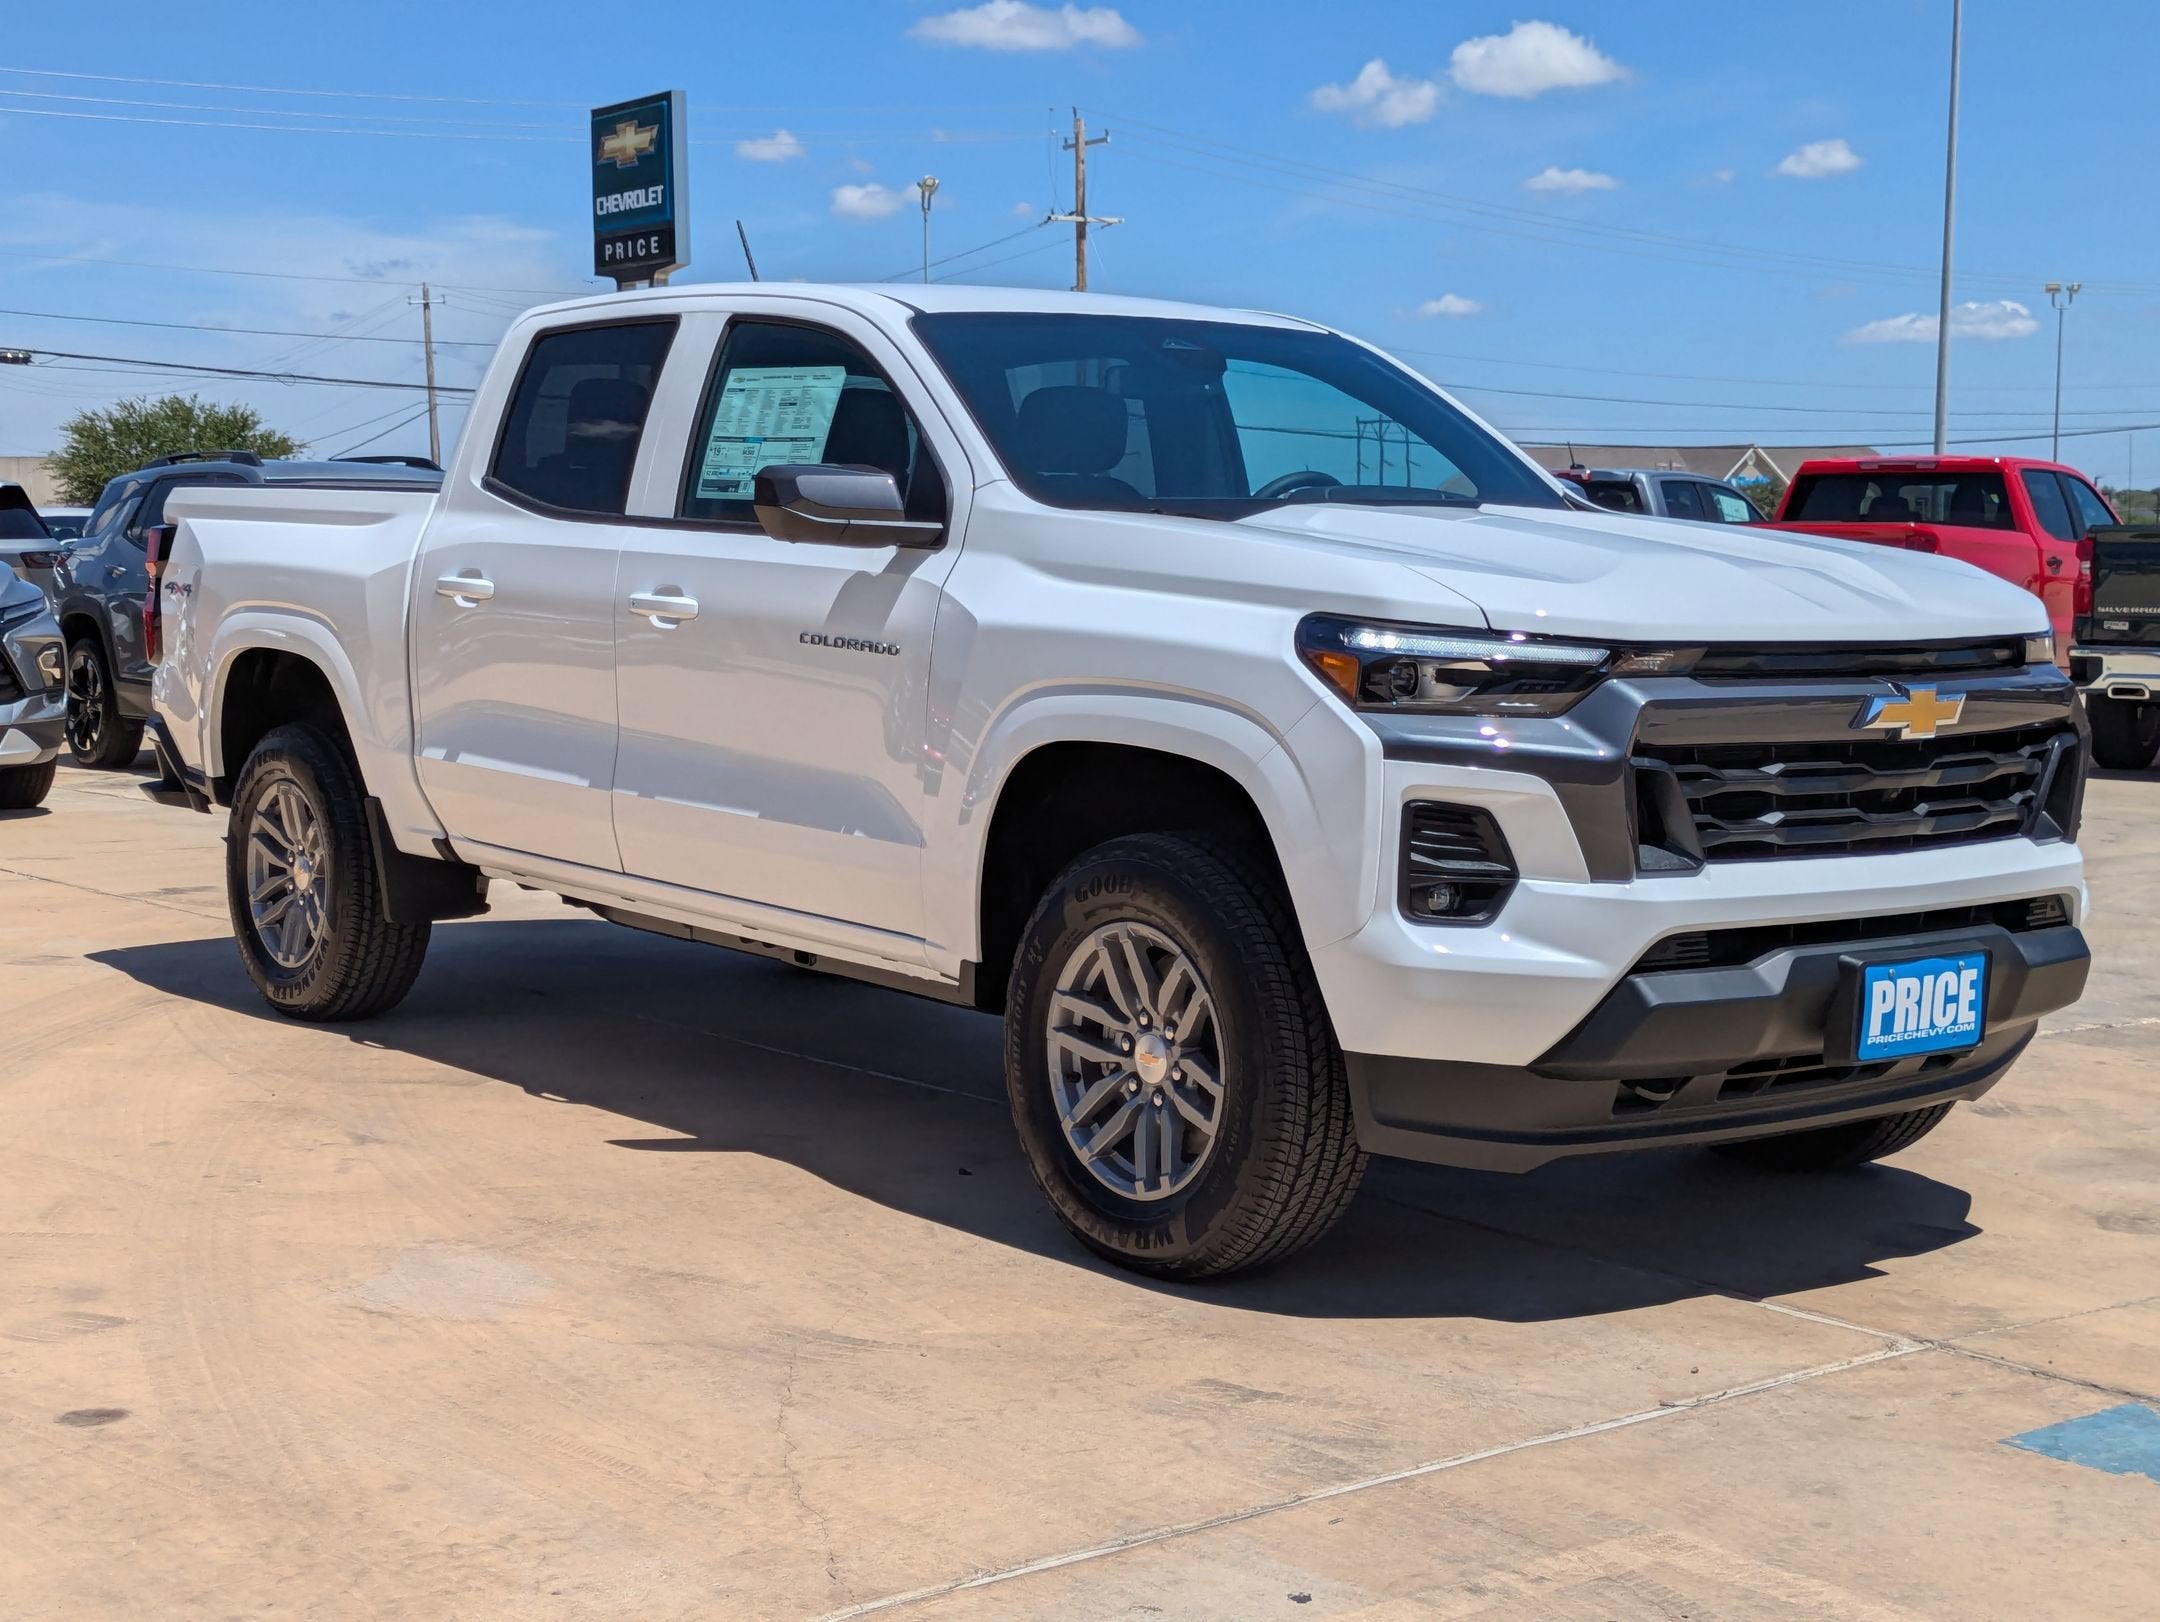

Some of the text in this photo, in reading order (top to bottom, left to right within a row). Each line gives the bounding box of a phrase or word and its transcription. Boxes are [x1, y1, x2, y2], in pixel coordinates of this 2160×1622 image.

[597, 185, 664, 215] CHEVROLET
[605, 236, 659, 261] PRICE
[799, 631, 901, 656] COLORADO
[1869, 968, 1978, 1036] PRICE
[1867, 1022, 1975, 1045] PRICECHEVY.COM
